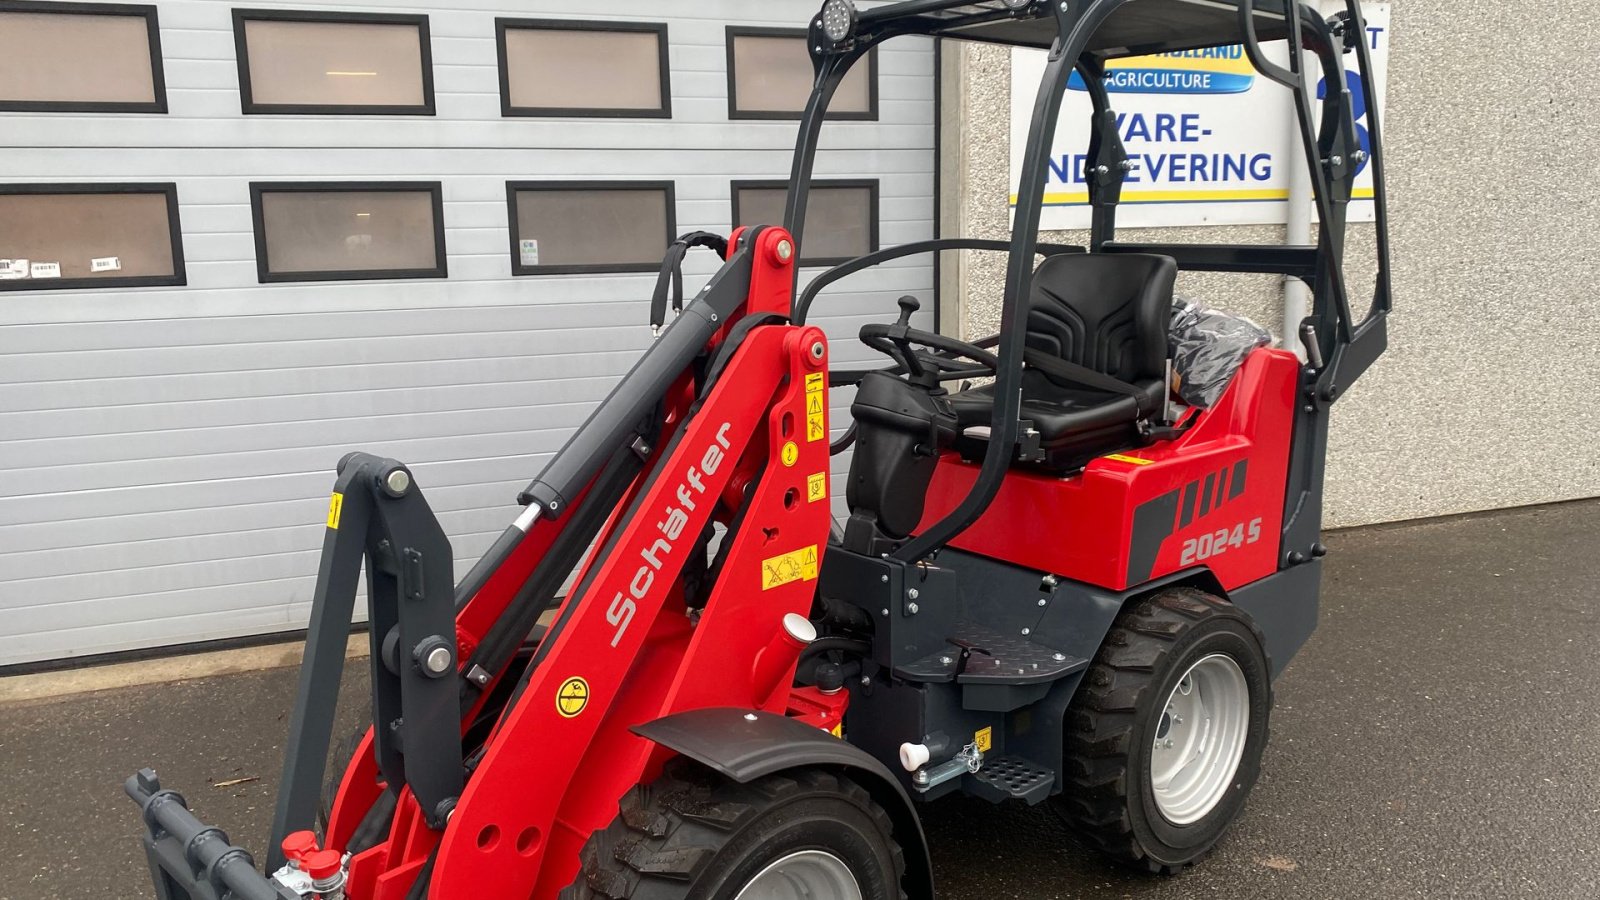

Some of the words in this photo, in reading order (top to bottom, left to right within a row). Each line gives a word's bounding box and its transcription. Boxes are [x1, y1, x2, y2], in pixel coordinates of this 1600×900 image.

[1104, 71, 1211, 88] AGRICULTURE
[606, 422, 731, 648] Schäffer
[1180, 523, 1244, 566] 2024
[1247, 517, 1262, 544] S
